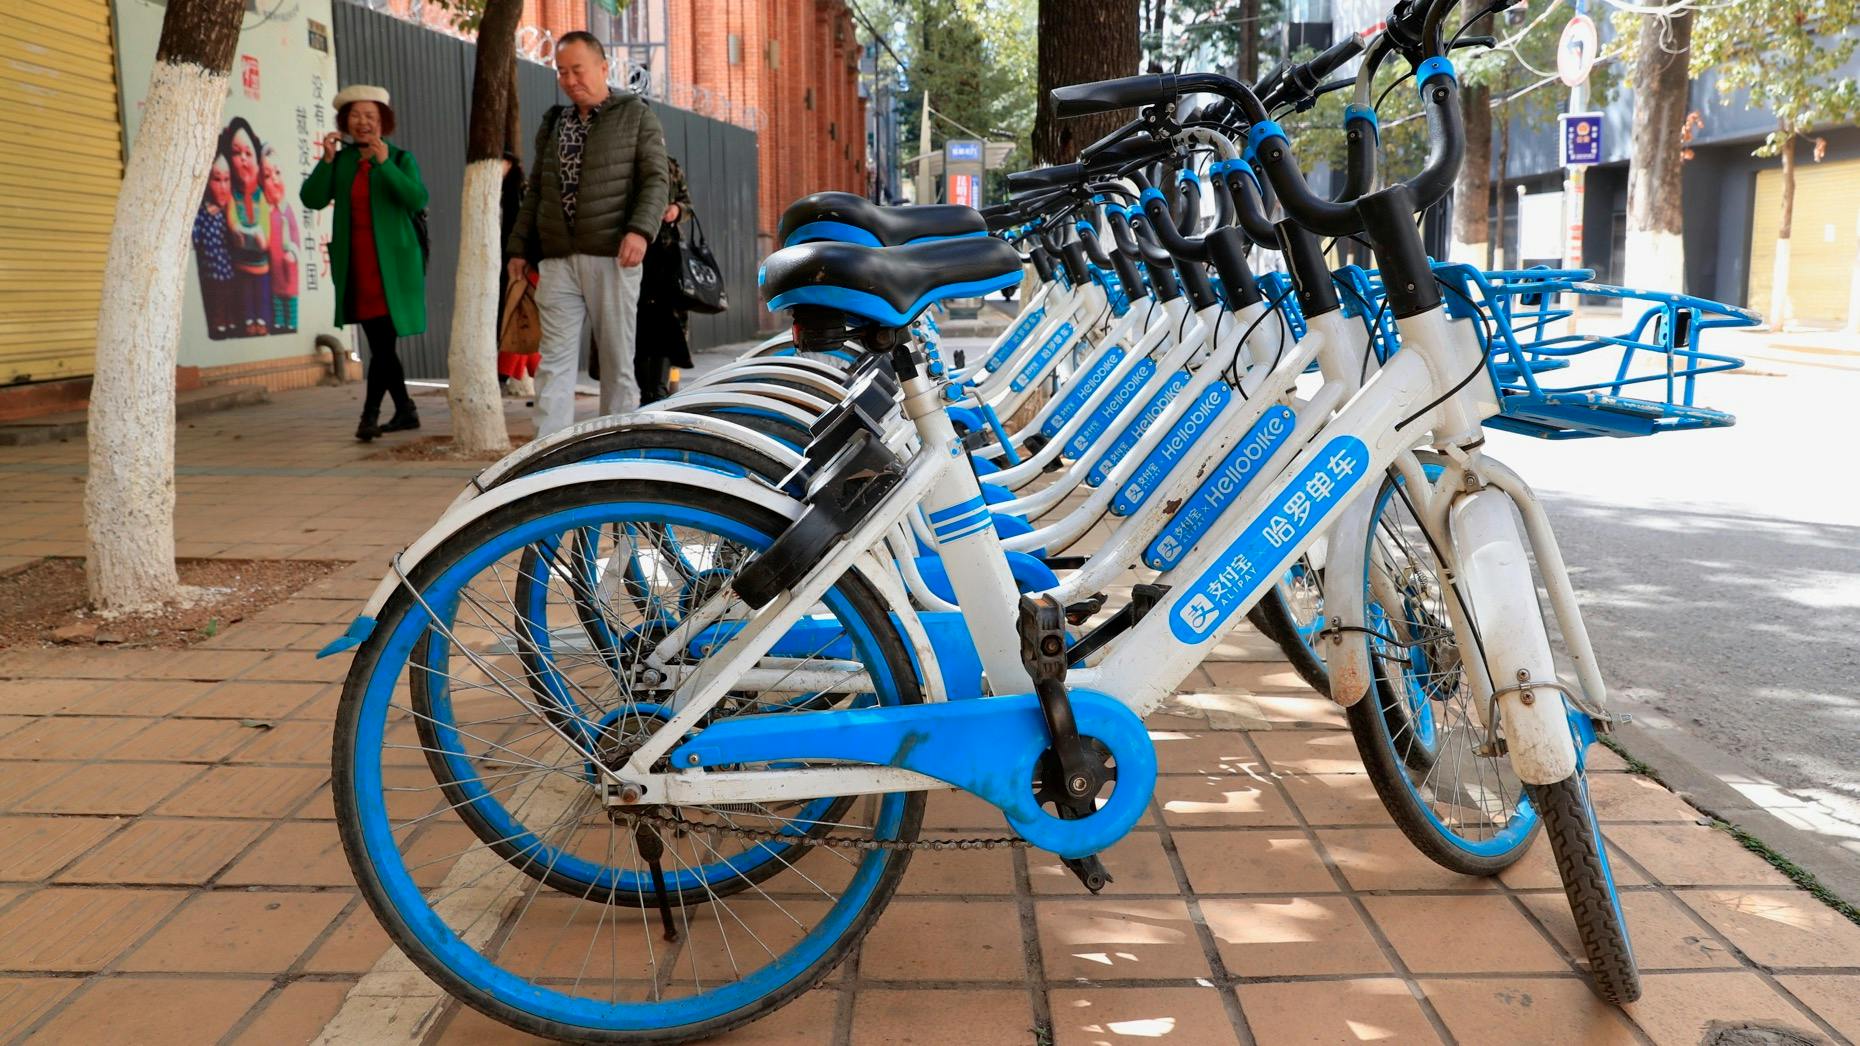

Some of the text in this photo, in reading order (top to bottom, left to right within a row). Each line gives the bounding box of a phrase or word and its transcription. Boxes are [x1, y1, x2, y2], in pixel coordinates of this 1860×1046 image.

[1077, 354, 1118, 400] Hellobike
[1102, 366, 1149, 418] Hellobike
[1162, 391, 1221, 460] Hellobike
[1204, 416, 1285, 508] Hellobike
[1174, 507, 1203, 539] 支付宝
[1206, 553, 1253, 601] 支付宝
[1262, 449, 1357, 549] 哈罗单车
[1221, 568, 1258, 607] ALIPAY
